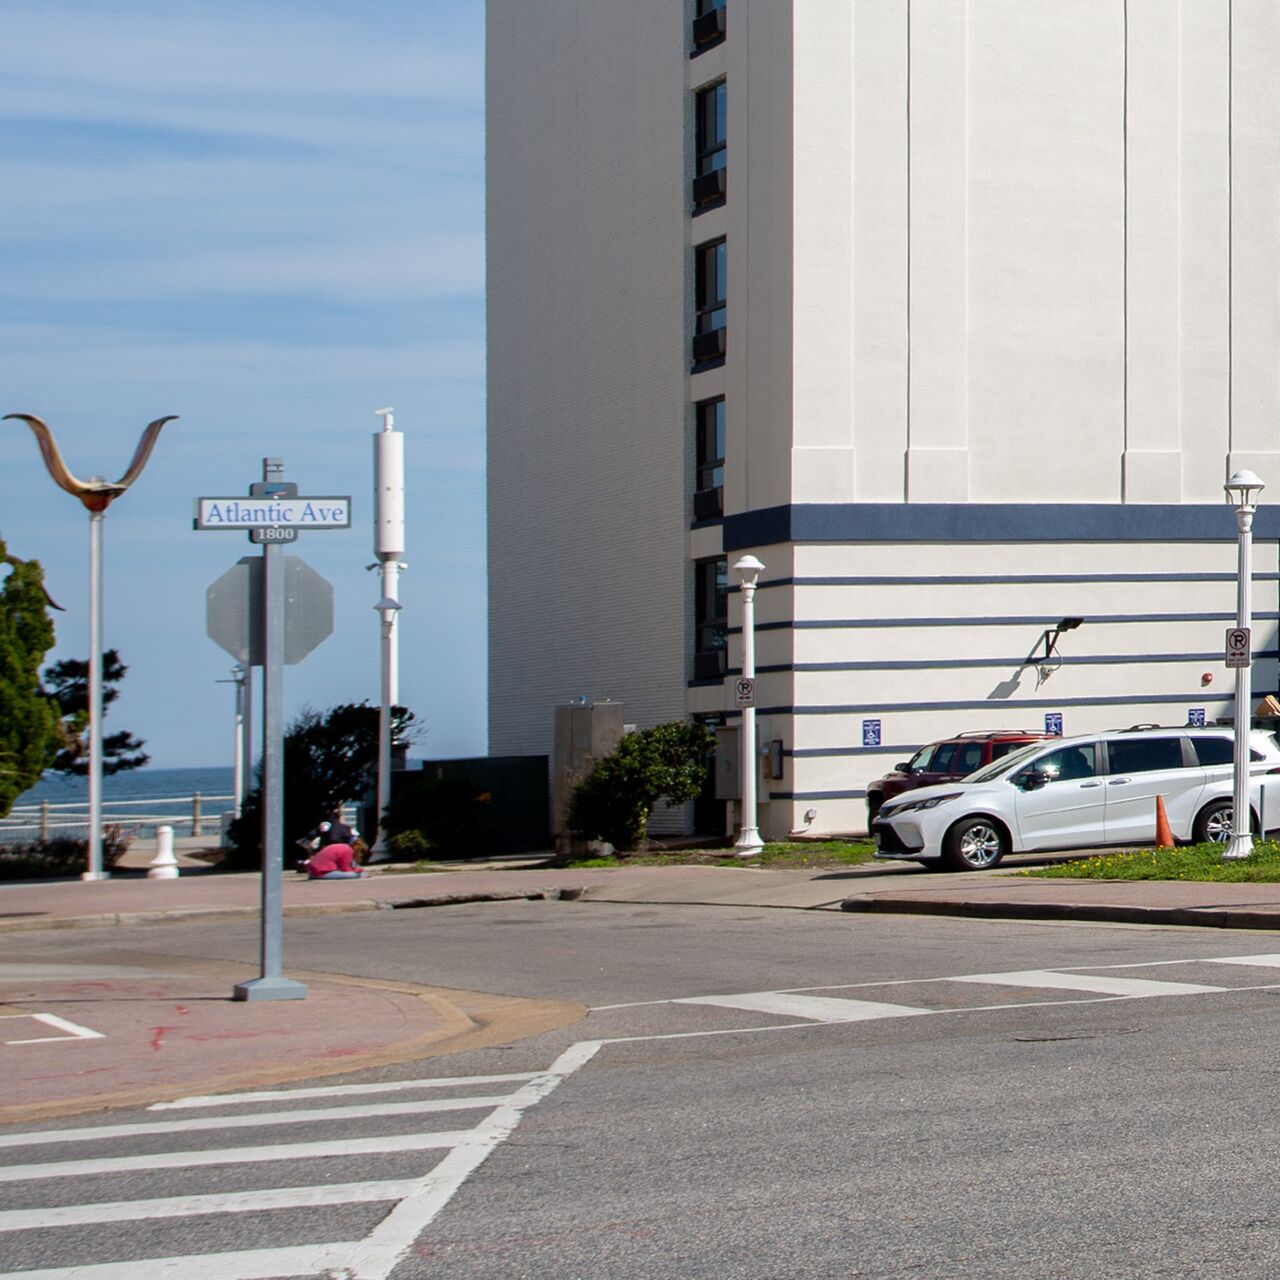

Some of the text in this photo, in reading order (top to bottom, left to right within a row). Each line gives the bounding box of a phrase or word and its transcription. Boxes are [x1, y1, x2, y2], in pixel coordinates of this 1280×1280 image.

[206, 502, 344, 523] Atlantic Ave
[258, 528, 294, 540] 1800
